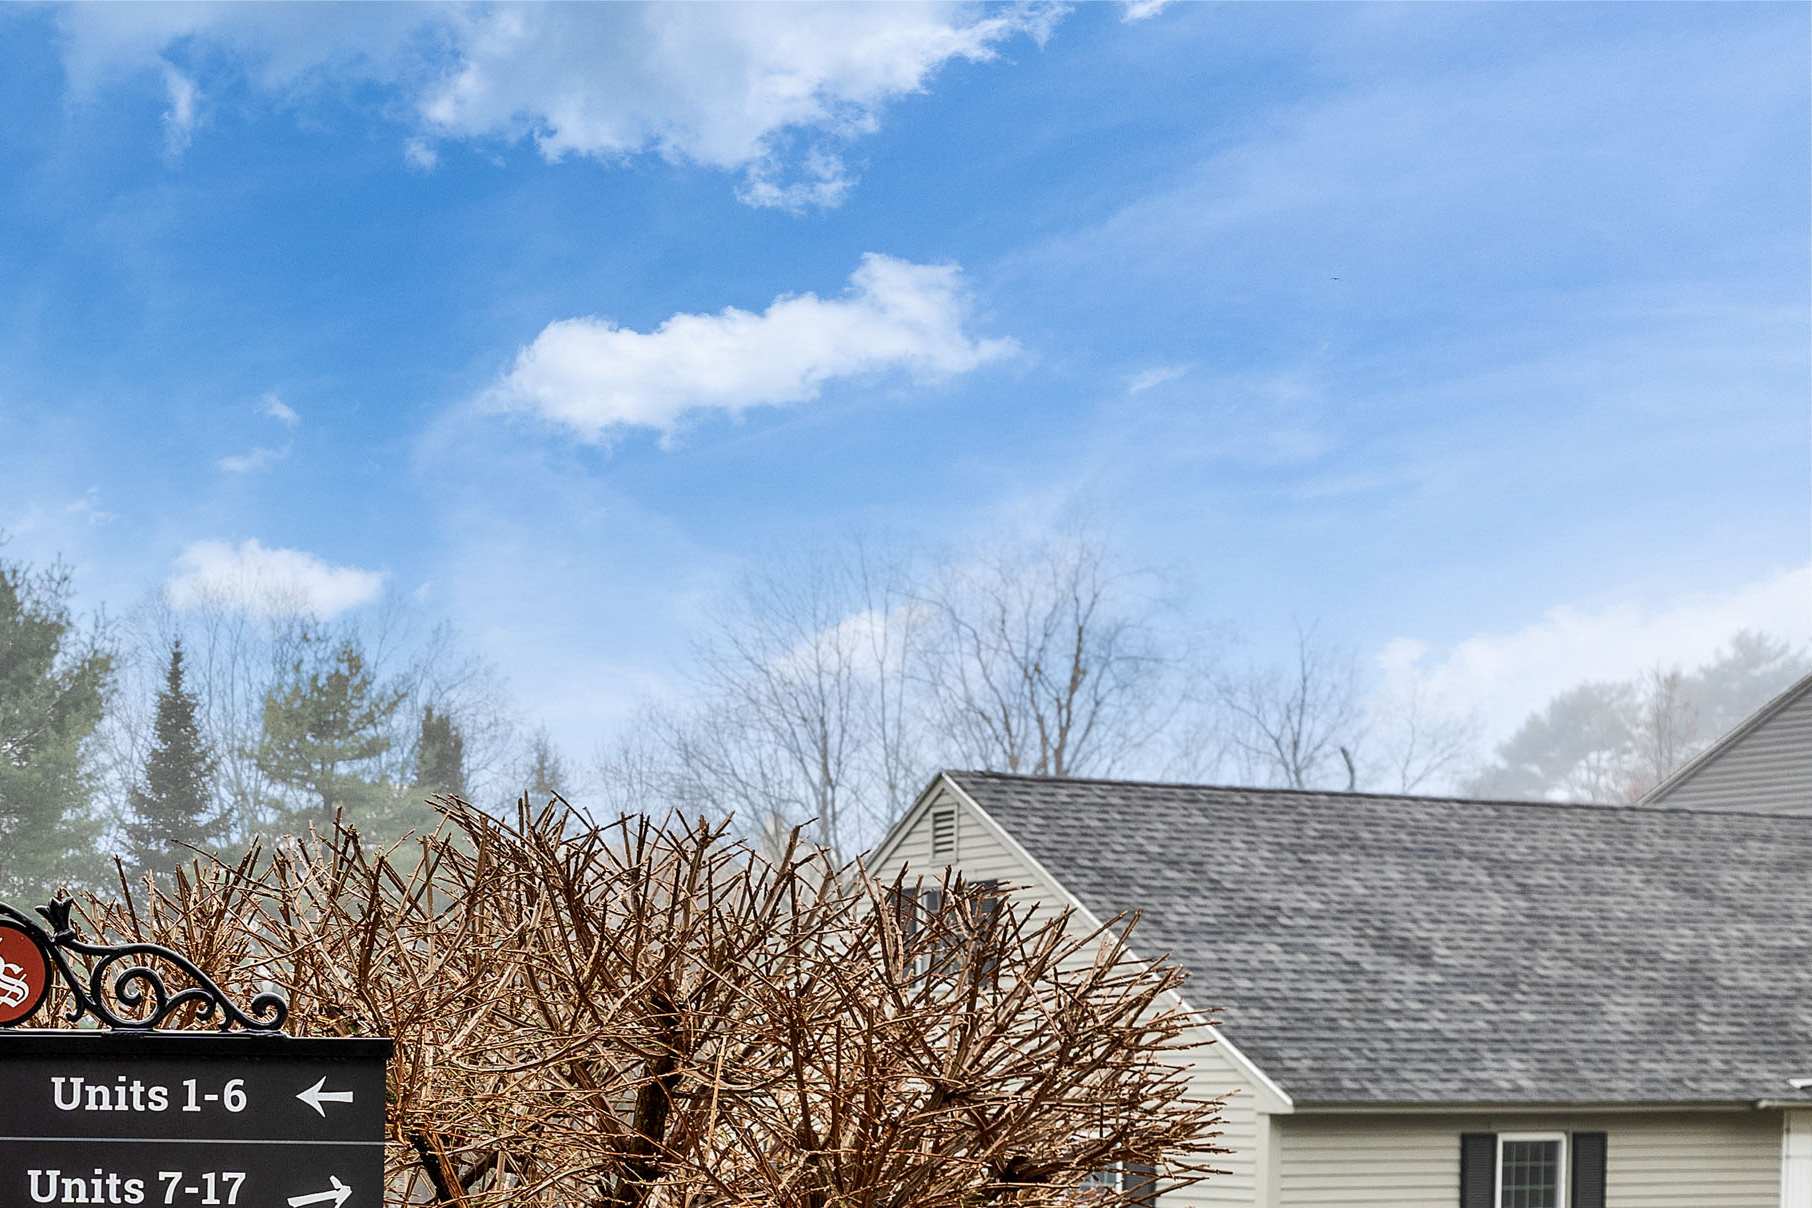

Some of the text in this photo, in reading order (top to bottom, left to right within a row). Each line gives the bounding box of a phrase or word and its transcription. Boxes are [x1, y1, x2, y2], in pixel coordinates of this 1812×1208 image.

[51, 1076, 248, 1112] Units 1-6
[27, 1168, 247, 1206] Units 7-17
